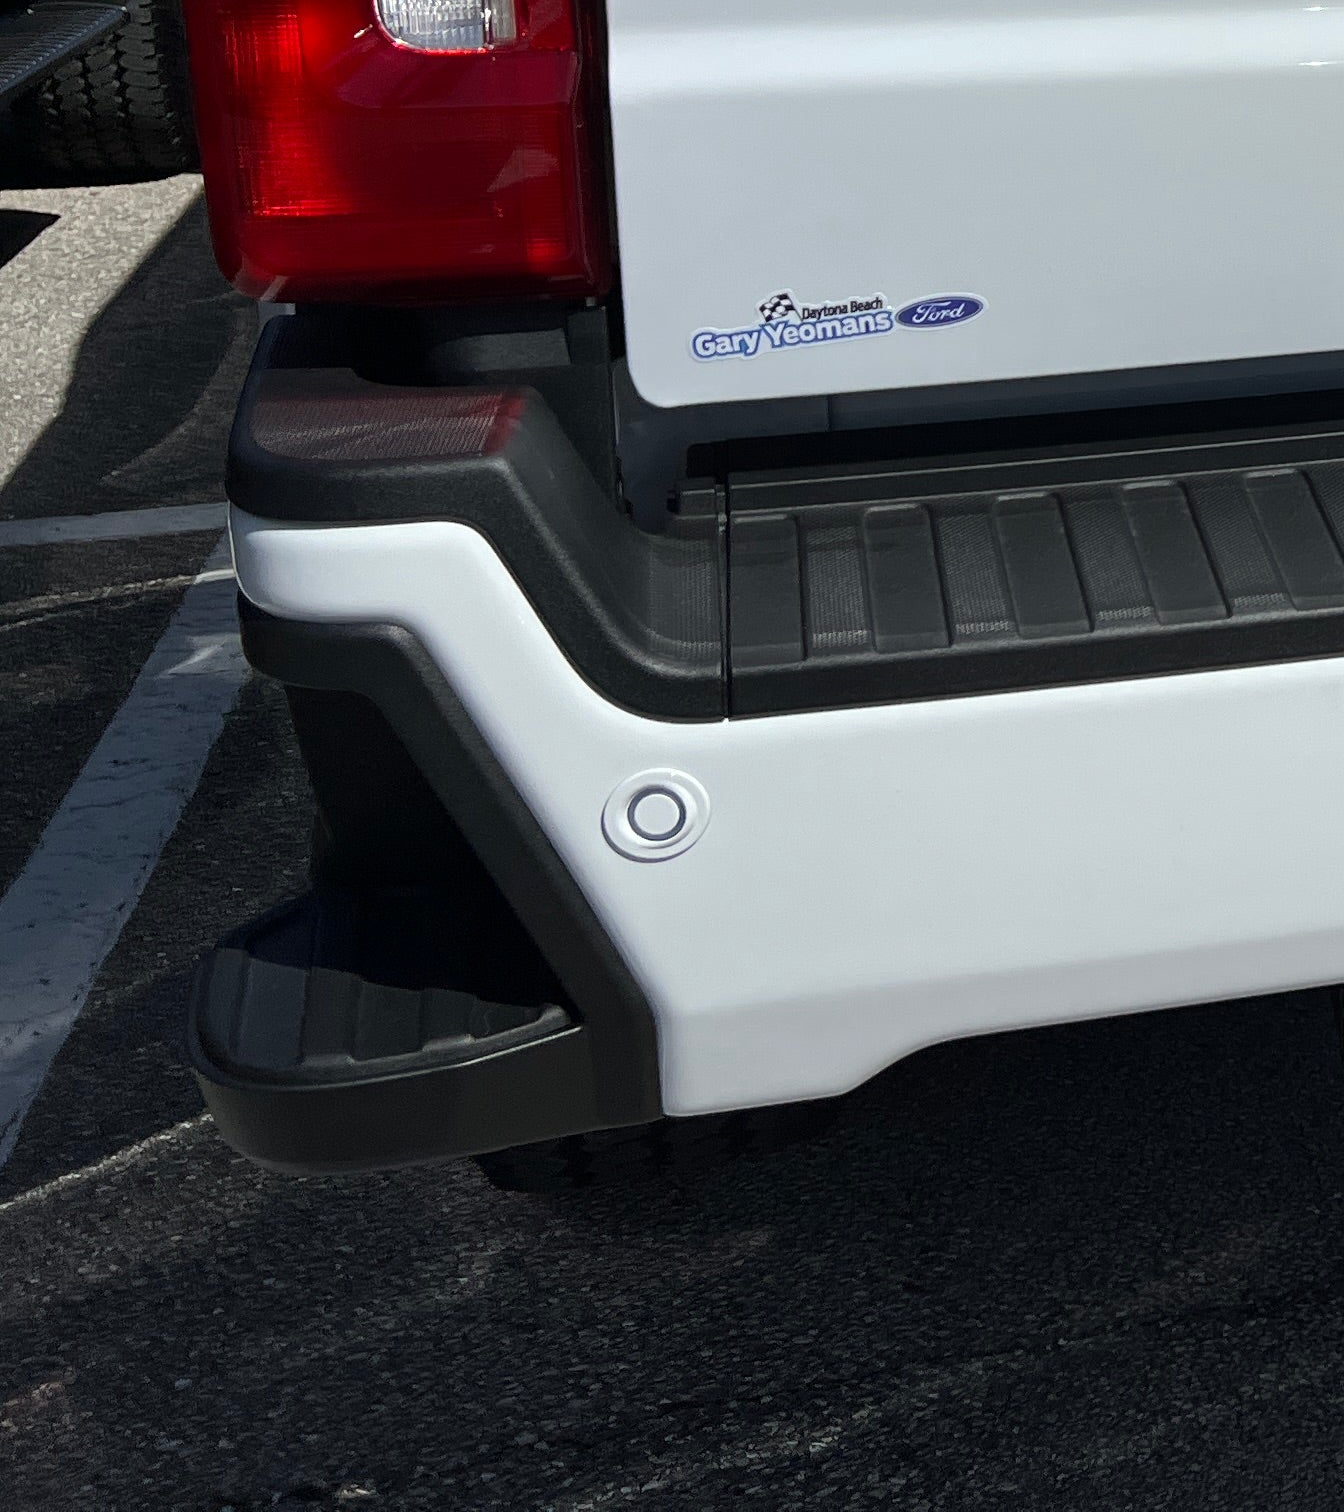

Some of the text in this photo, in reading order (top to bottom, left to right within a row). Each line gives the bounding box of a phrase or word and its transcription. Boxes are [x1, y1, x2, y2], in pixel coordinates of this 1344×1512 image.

[801, 296, 883, 321] Daytona Beach
[911, 301, 966, 324] Ford
[693, 310, 895, 357] Gary Yeomans
